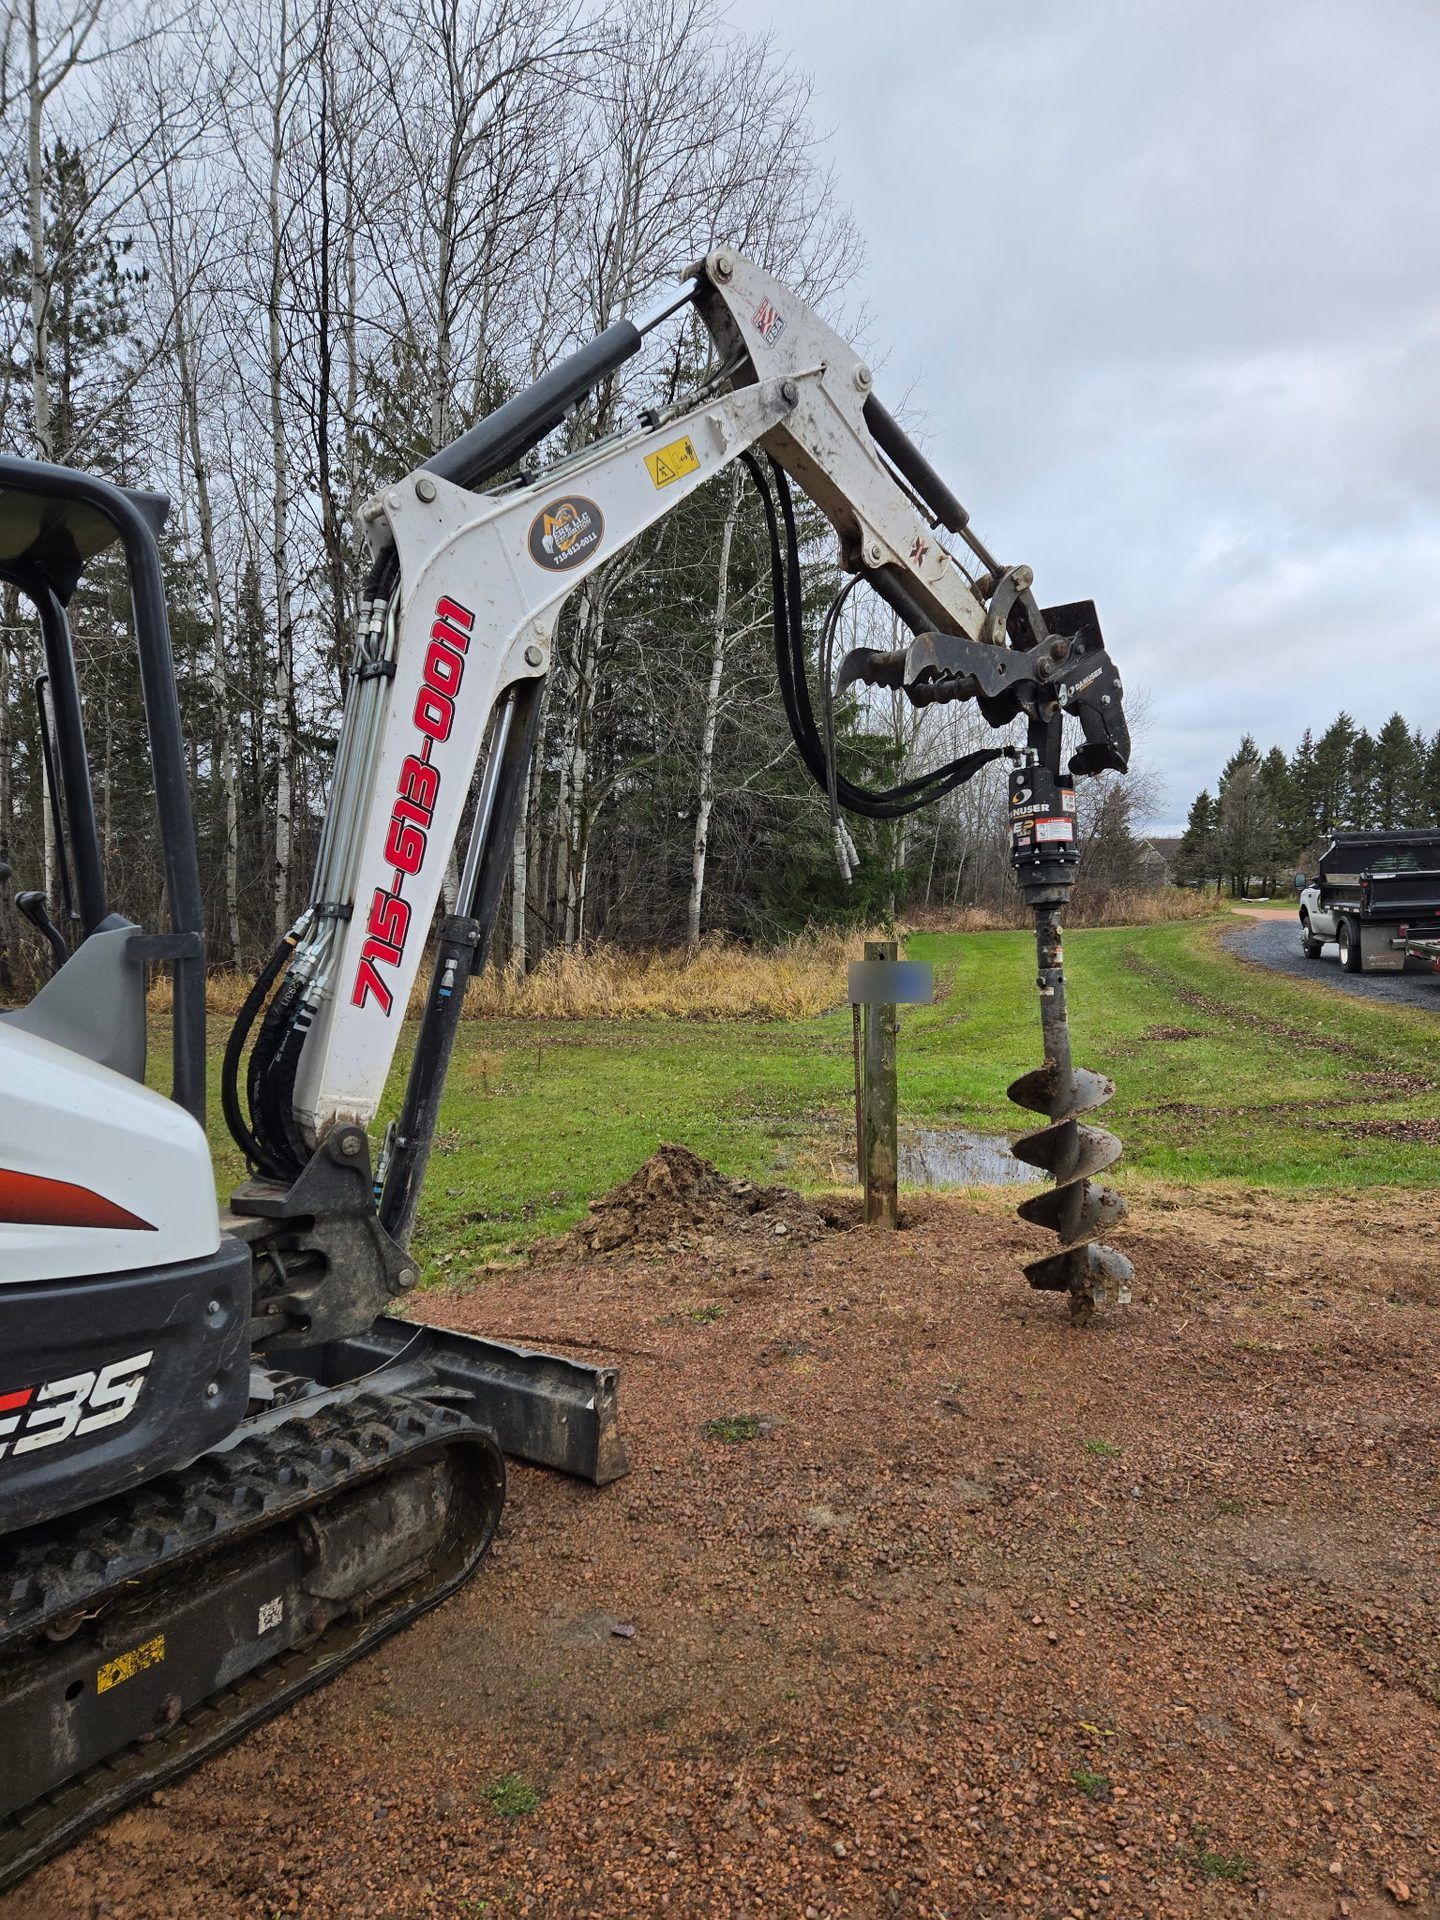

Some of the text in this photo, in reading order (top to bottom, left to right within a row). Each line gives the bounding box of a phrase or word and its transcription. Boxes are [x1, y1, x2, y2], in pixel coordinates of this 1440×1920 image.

[766, 319, 783, 344] USA
[572, 512, 589, 527] LLC
[350, 595, 476, 1018] 715-613-0011
